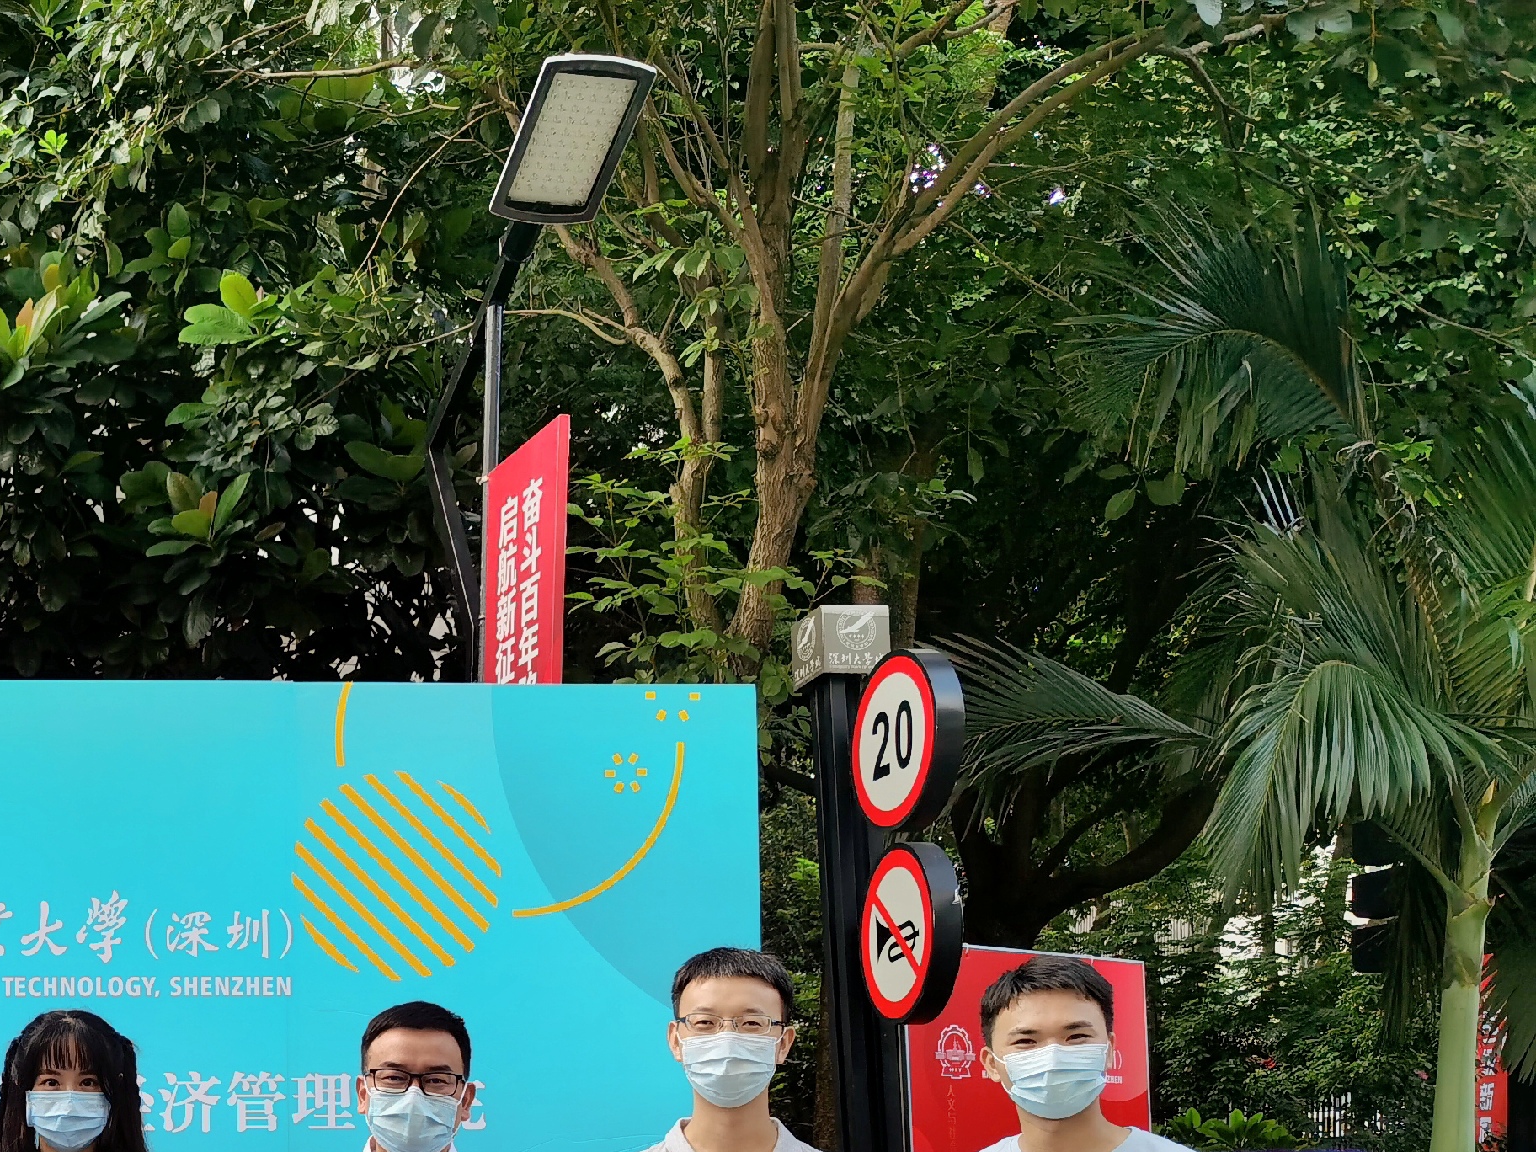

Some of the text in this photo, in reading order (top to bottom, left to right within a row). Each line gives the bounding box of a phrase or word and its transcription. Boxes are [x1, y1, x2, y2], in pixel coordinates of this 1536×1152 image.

[871, 700, 913, 781] 20
[2, 976, 160, 998] TECHNOLOGY,
[170, 976, 292, 997] SHENZHEN
